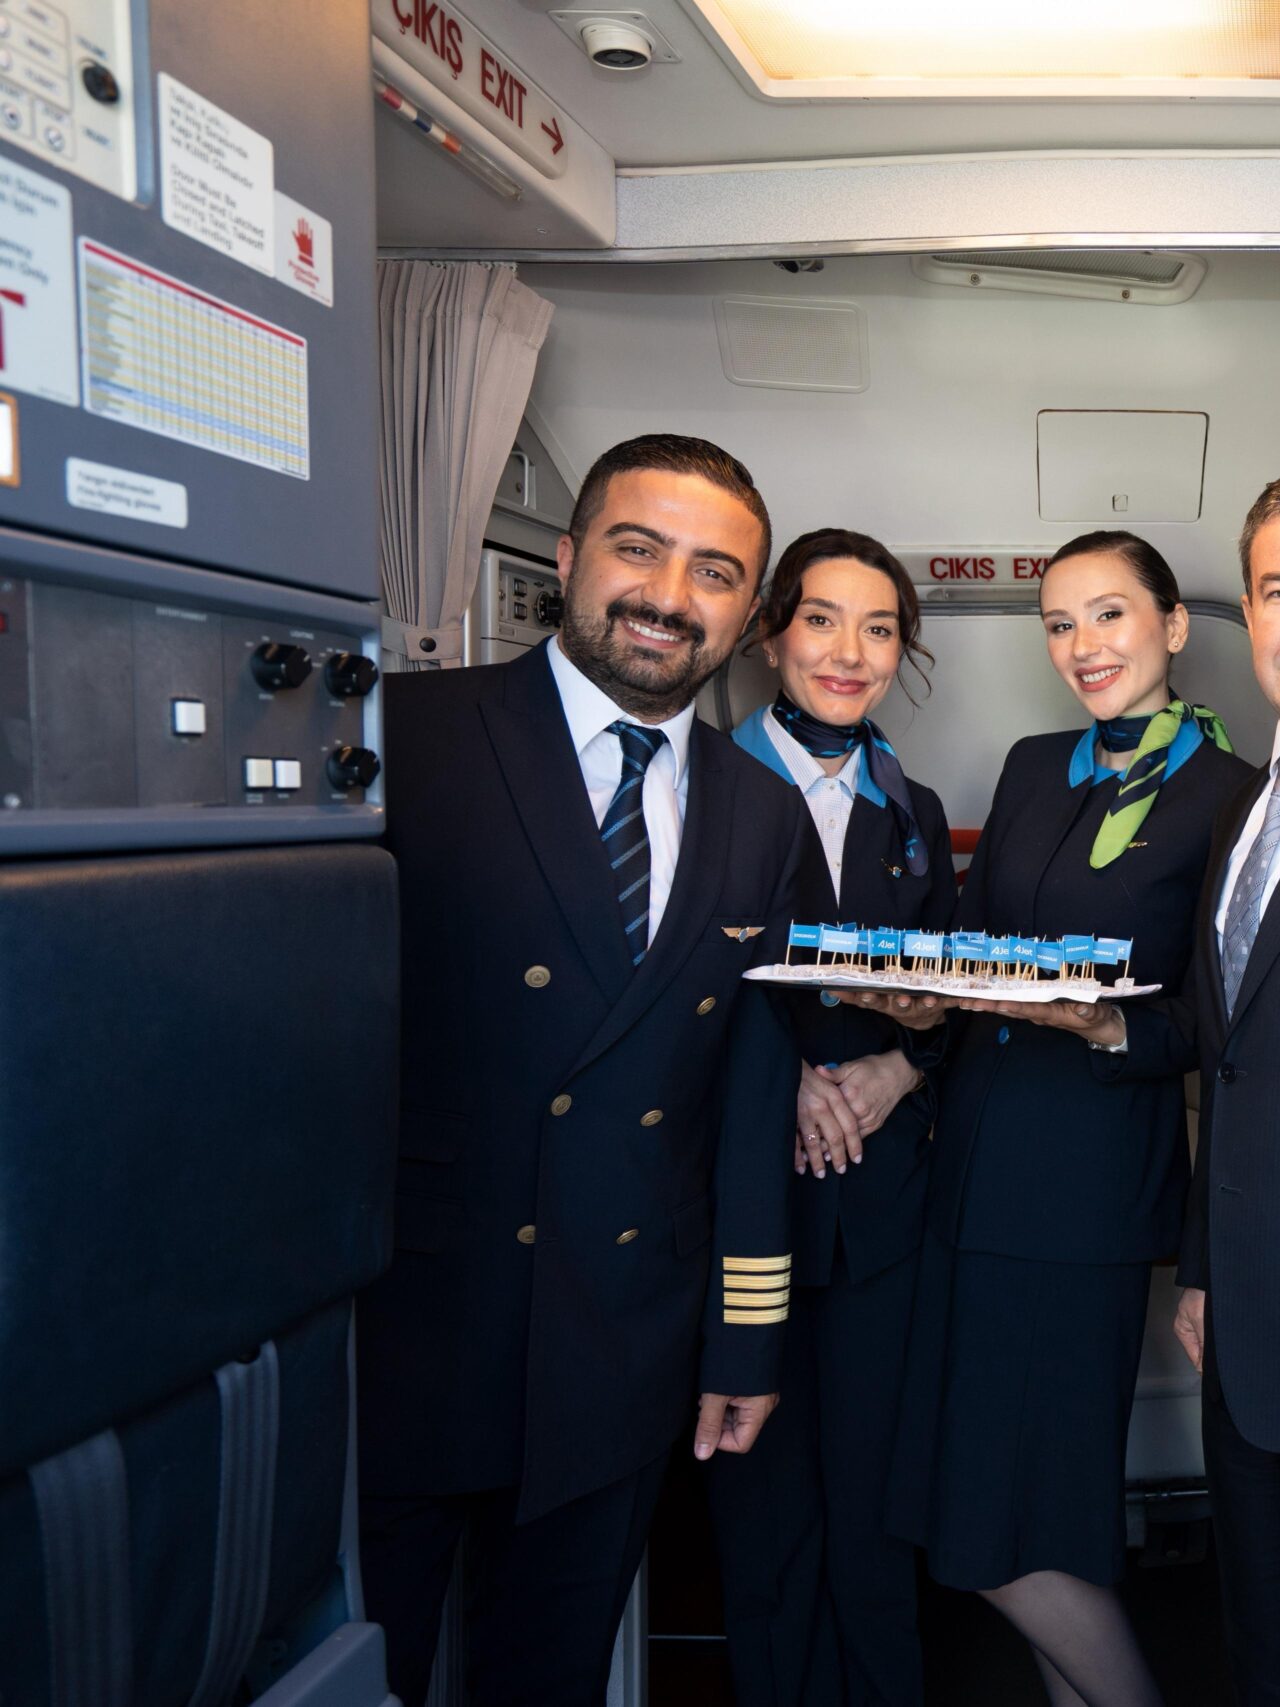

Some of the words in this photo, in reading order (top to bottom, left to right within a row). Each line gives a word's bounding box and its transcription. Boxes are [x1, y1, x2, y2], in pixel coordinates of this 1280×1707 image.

[480, 47, 528, 129] EXIT
[929, 557, 996, 583] ÇIKIŞ
[1013, 557, 1053, 580] EXI
[878, 939, 895, 949] AJet
[911, 941, 937, 953] AJet
[991, 945, 1009, 955] AJe
[1013, 944, 1033, 956] AJet
